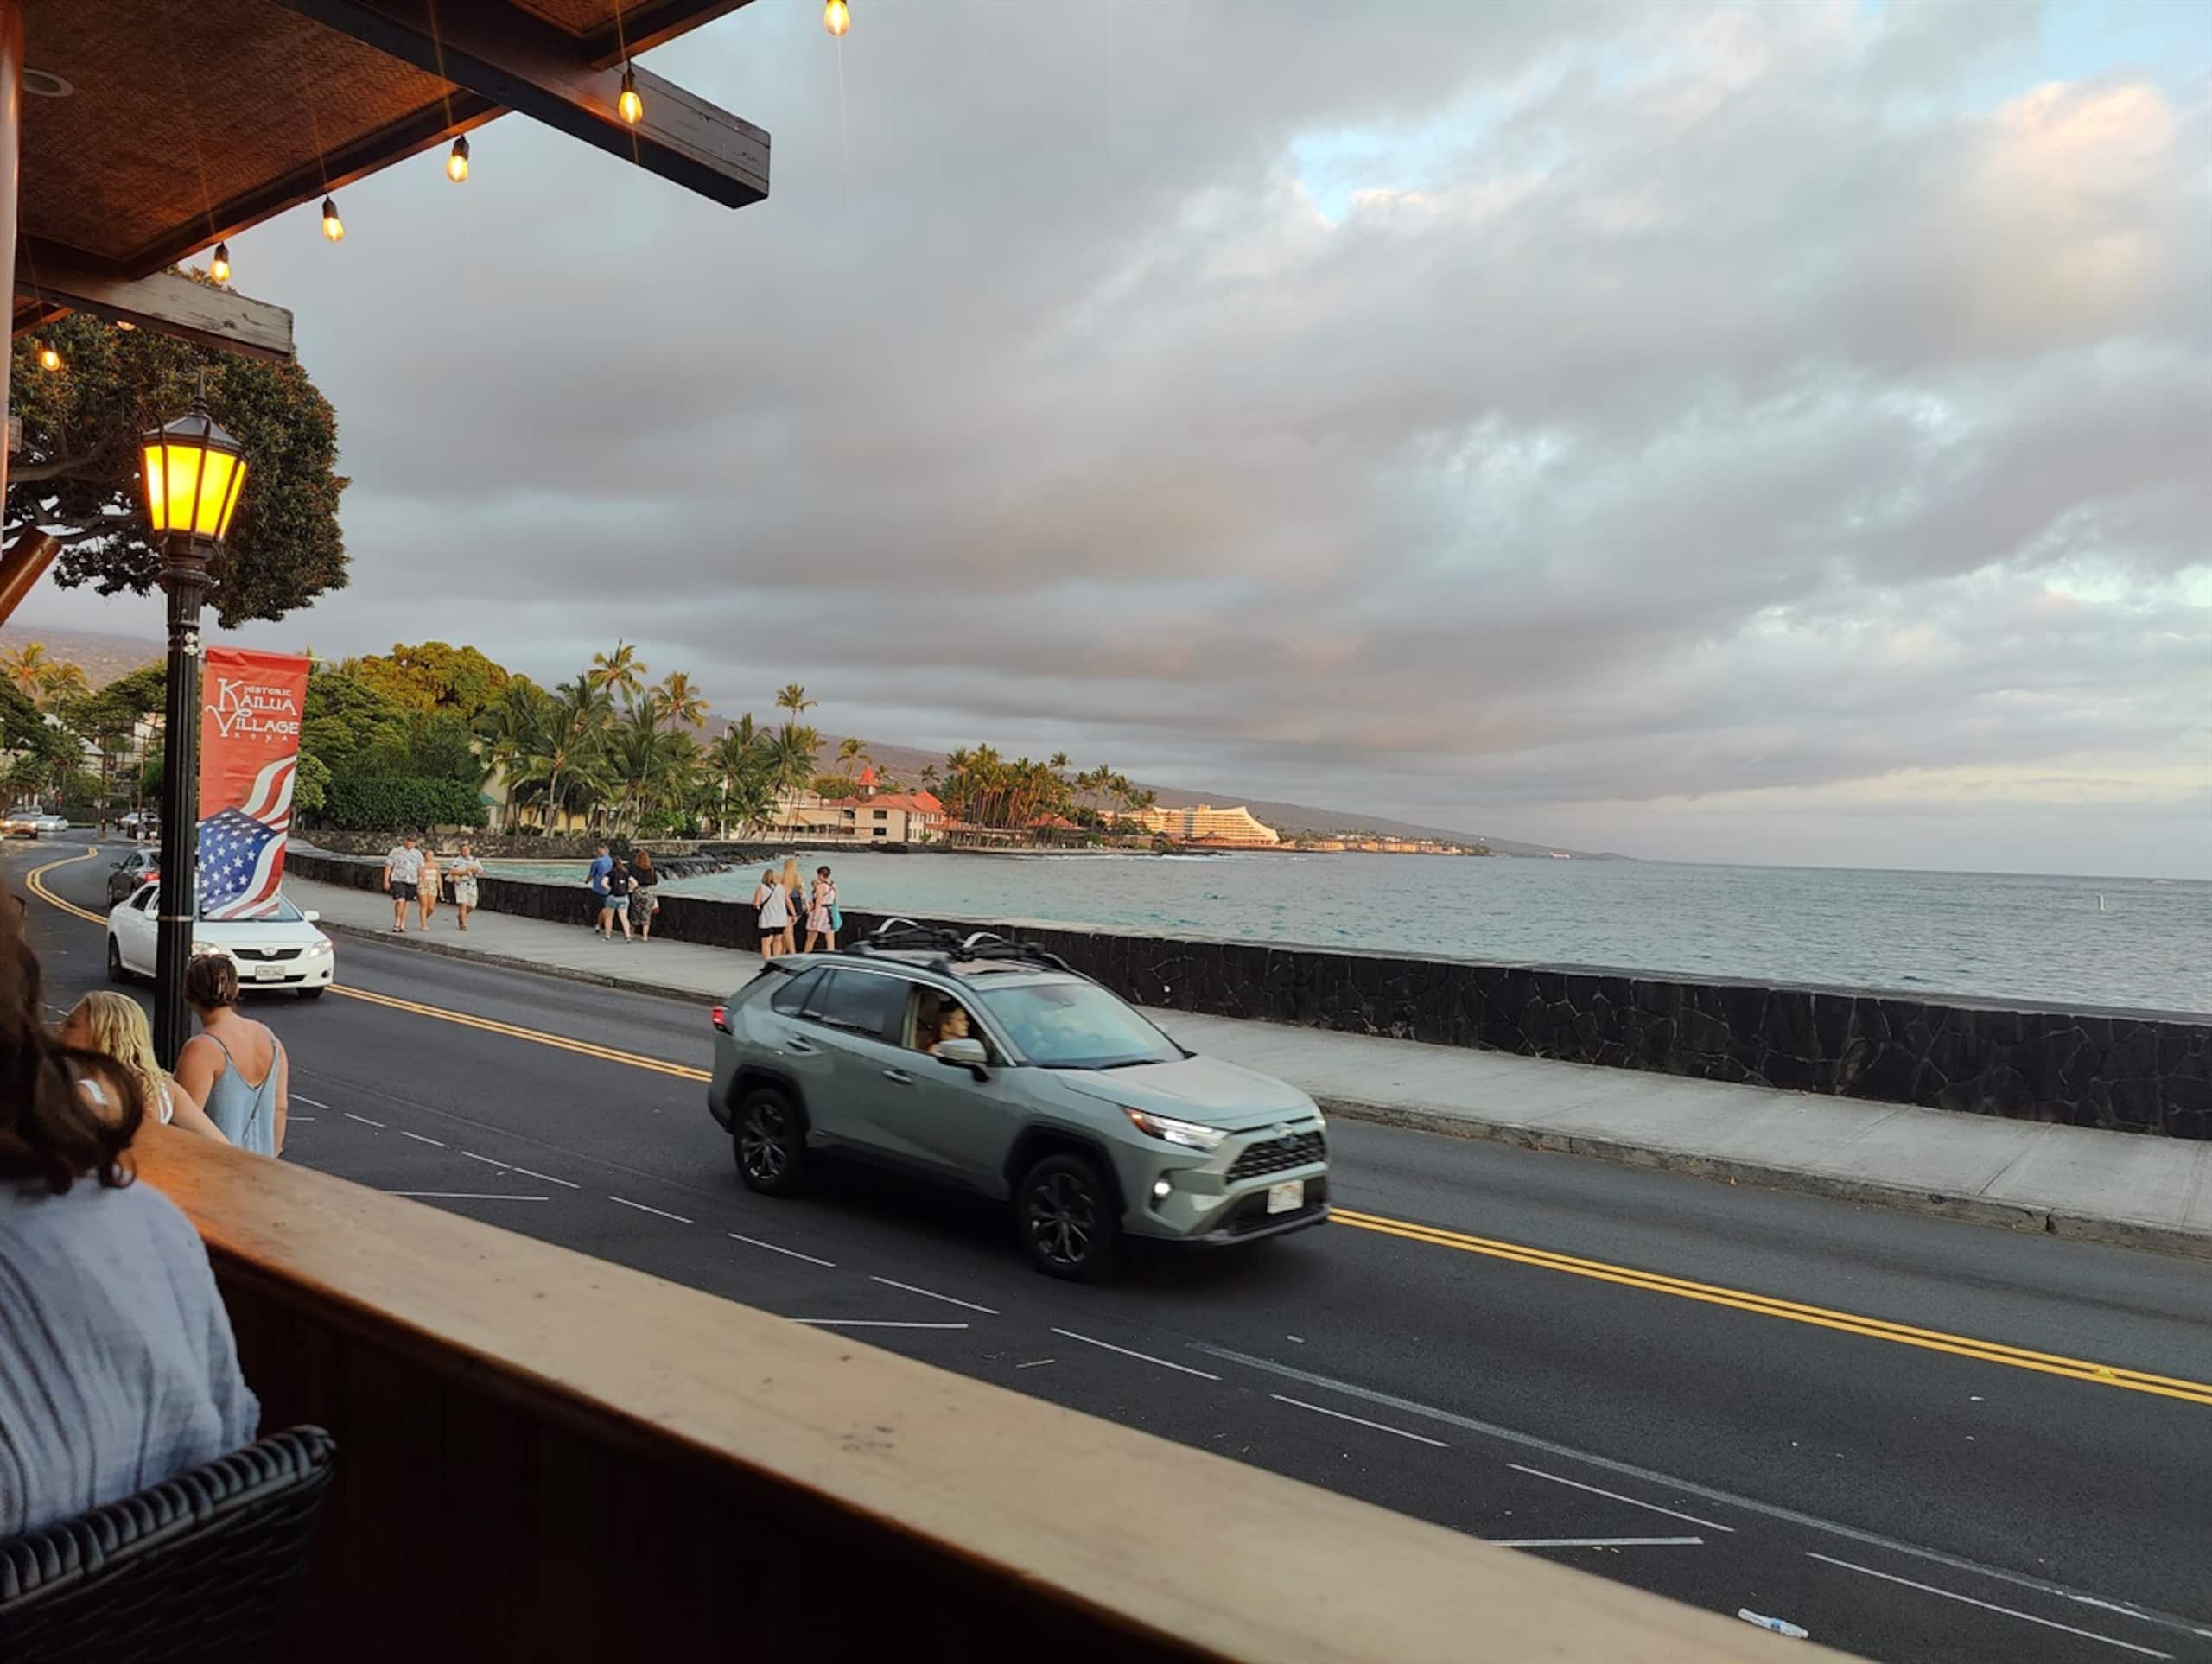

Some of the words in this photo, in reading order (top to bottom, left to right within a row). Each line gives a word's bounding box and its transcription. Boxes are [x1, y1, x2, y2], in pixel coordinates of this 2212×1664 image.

[217, 677, 297, 716] KAILUA
[244, 685, 292, 696] HISTORIC
[204, 704, 300, 738] VILLAGE
